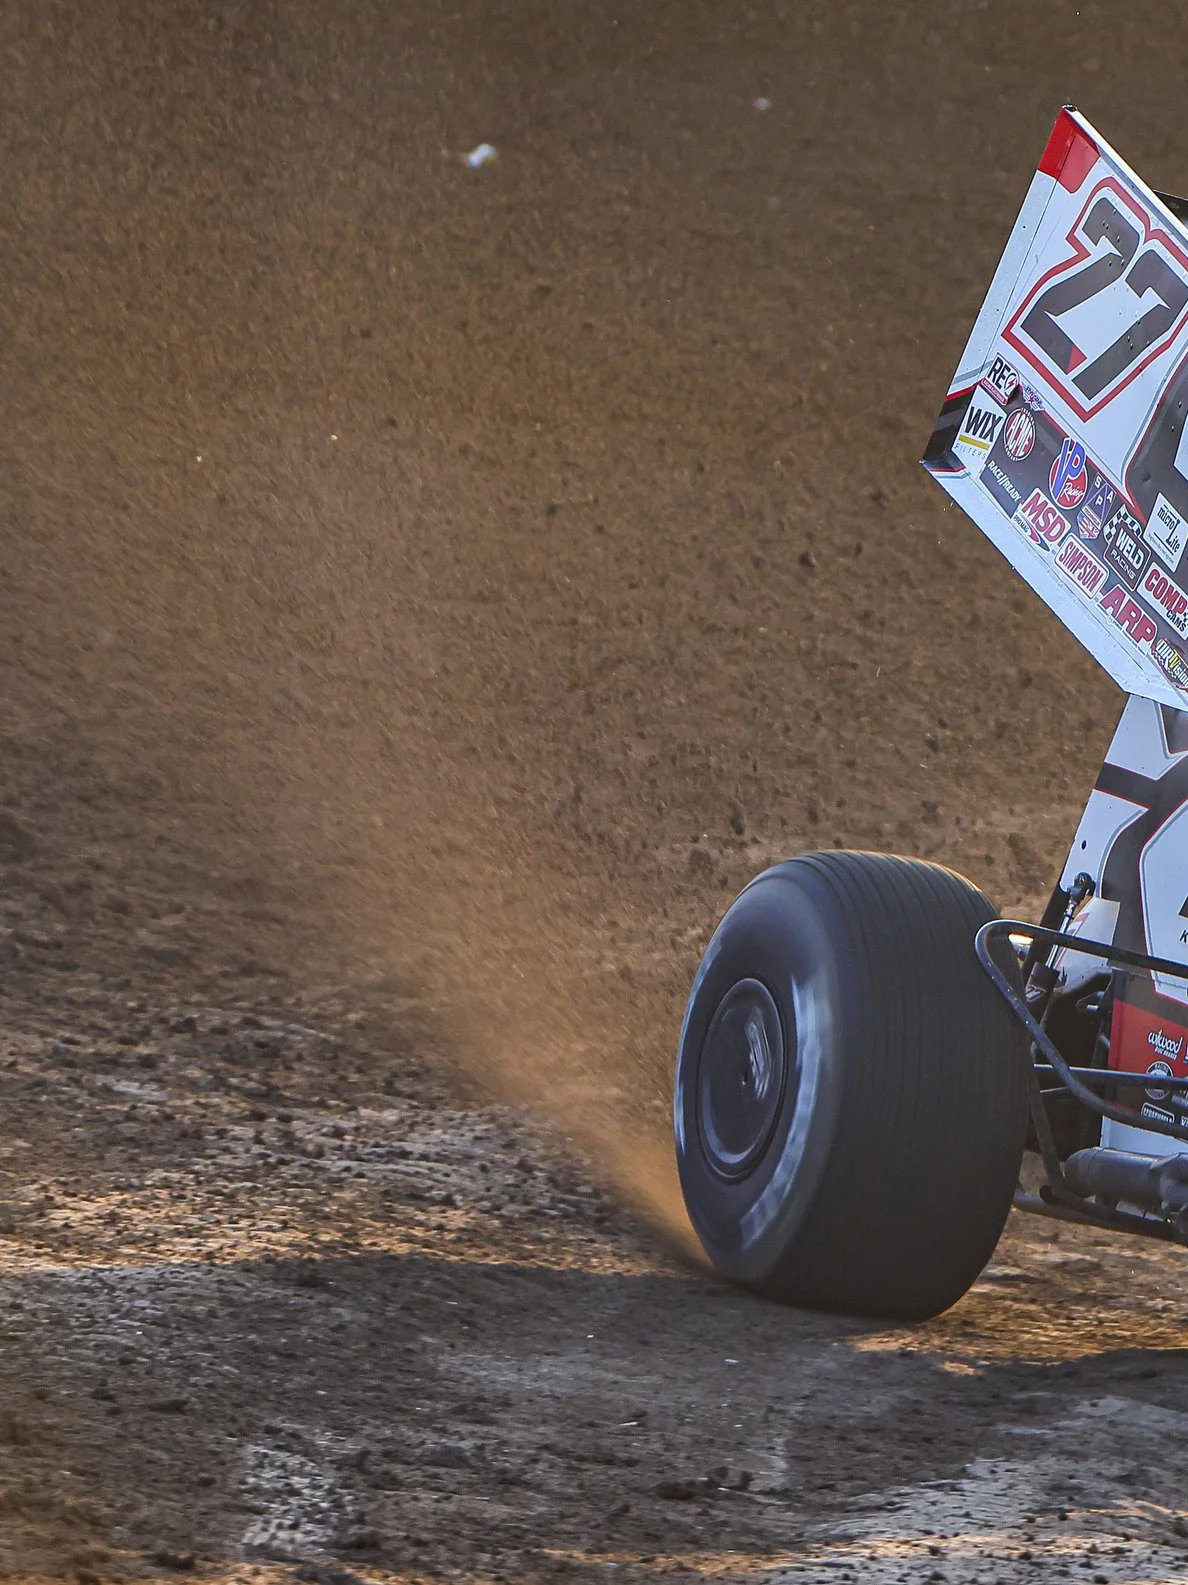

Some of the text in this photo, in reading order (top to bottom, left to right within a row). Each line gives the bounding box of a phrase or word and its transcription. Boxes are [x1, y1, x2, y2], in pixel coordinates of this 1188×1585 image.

[965, 406, 1003, 442] WIX
[1006, 411, 1033, 457] ACME
[954, 442, 987, 460] FILTERS
[1052, 439, 1085, 500] VP
[1060, 482, 1085, 503] Racing
[1021, 492, 1066, 543] MSD
[1157, 506, 1175, 530] micro
[1059, 541, 1104, 592] SIMPSON
[1110, 549, 1136, 580] RACING
[1116, 527, 1145, 570] WELD
[1144, 568, 1188, 615] COMP
[1100, 585, 1157, 644] ARP
[1166, 609, 1187, 632] CAMS
